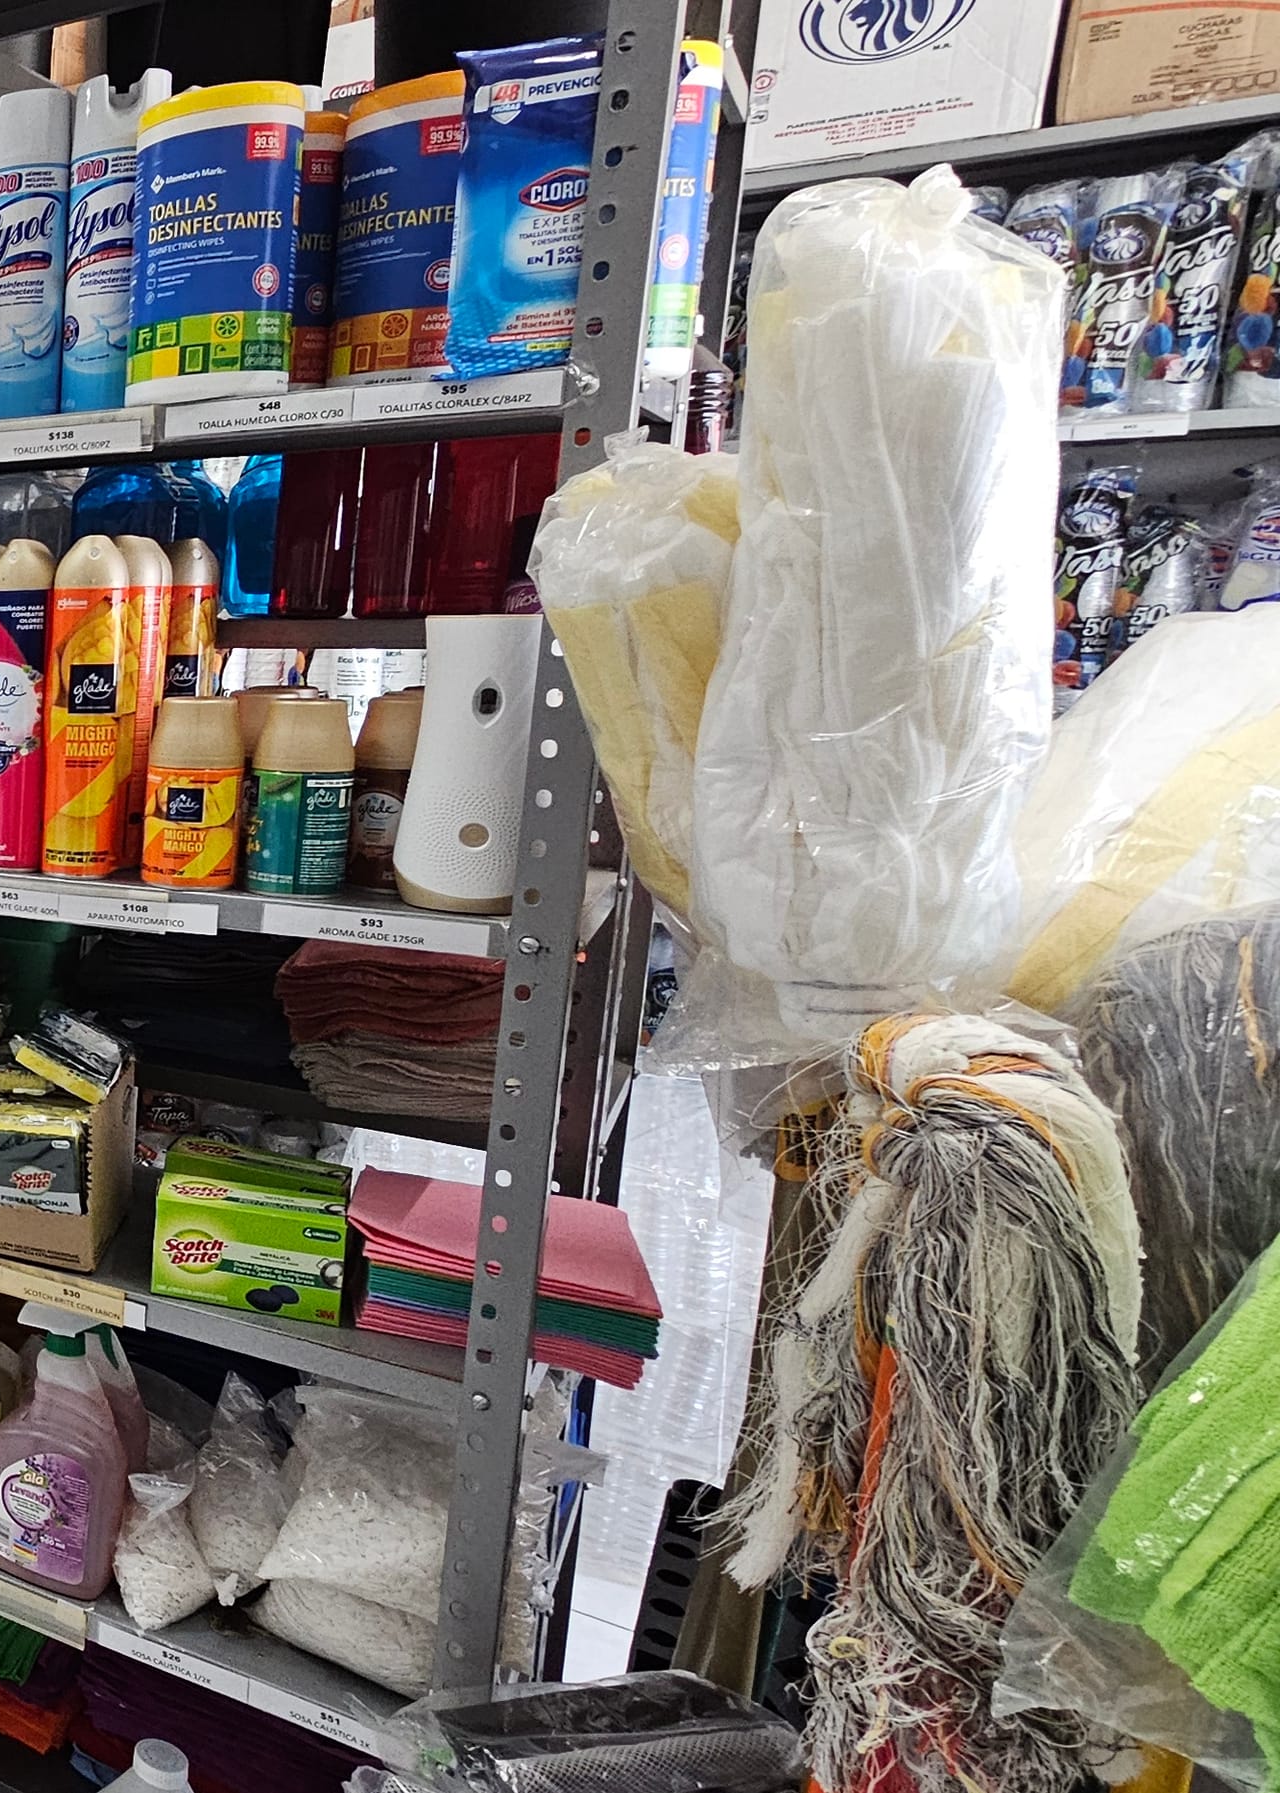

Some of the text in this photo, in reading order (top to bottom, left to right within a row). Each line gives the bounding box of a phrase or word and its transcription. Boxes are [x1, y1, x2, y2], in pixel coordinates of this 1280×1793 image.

[1178, 16, 1243, 34] CUCHARAS
[1186, 27, 1231, 41] CHICAS
[494, 84, 521, 101] 48
[254, 136, 280, 149] 99.9%
[76, 158, 105, 183] 100
[148, 193, 217, 223] TOALLAS
[68, 194, 134, 256] Lysol
[148, 211, 282, 245] DESINFECTANTES
[198, 236, 225, 248] WIPES
[527, 249, 553, 266] EN 1
[1157, 226, 1236, 276] Vaso
[1074, 266, 1154, 315] Vaso
[1179, 284, 1219, 314] 50
[516, 311, 549, 321] Elimina
[522, 318, 560, 329] Bacterias
[1095, 322, 1140, 347] 50
[441, 384, 467, 395] $95
[258, 401, 281, 411] $48
[379, 393, 532, 414] TOALLITAS CLORALEX C/84PZ
[198, 409, 344, 430] TOALLA HUMEDA CLOROX C/30
[48, 431, 74, 440] $138
[14, 446, 55, 456] TOALLITAS
[1130, 605, 1168, 625] 50
[1083, 618, 1113, 636] 50
[73, 677, 115, 704] glade
[65, 741, 115, 757] MANGO
[169, 796, 199, 814] glade
[307, 791, 337, 811] glade
[358, 801, 398, 821] glade
[164, 829, 207, 843] MIGHTY
[163, 840, 204, 853] MANGO
[1, 891, 20, 901] $63
[14, 905, 39, 913] GLADE
[121, 903, 149, 913] $108
[87, 911, 185, 929] APARATO AUTOMATICO
[360, 918, 384, 928] $93
[318, 927, 425, 945] AROMA GLADE 175GR
[151, 1107, 189, 1123] Tapa
[18, 1179, 49, 1190] Brite
[304, 1228, 312, 1237] 4
[170, 1251, 221, 1264] Brite
[23, 1287, 53, 1302] SCOTCH
[63, 1289, 81, 1299] $30
[316, 1309, 336, 1321] 3M
[24, 1471, 43, 1486] ala
[10, 1483, 50, 1508] Lavanda
[131, 1650, 191, 1677] SOSA CAUSTICA
[161, 1651, 181, 1662] $26
[320, 1712, 341, 1725] $51
[289, 1711, 357, 1743] SOSA CAUSTICA
